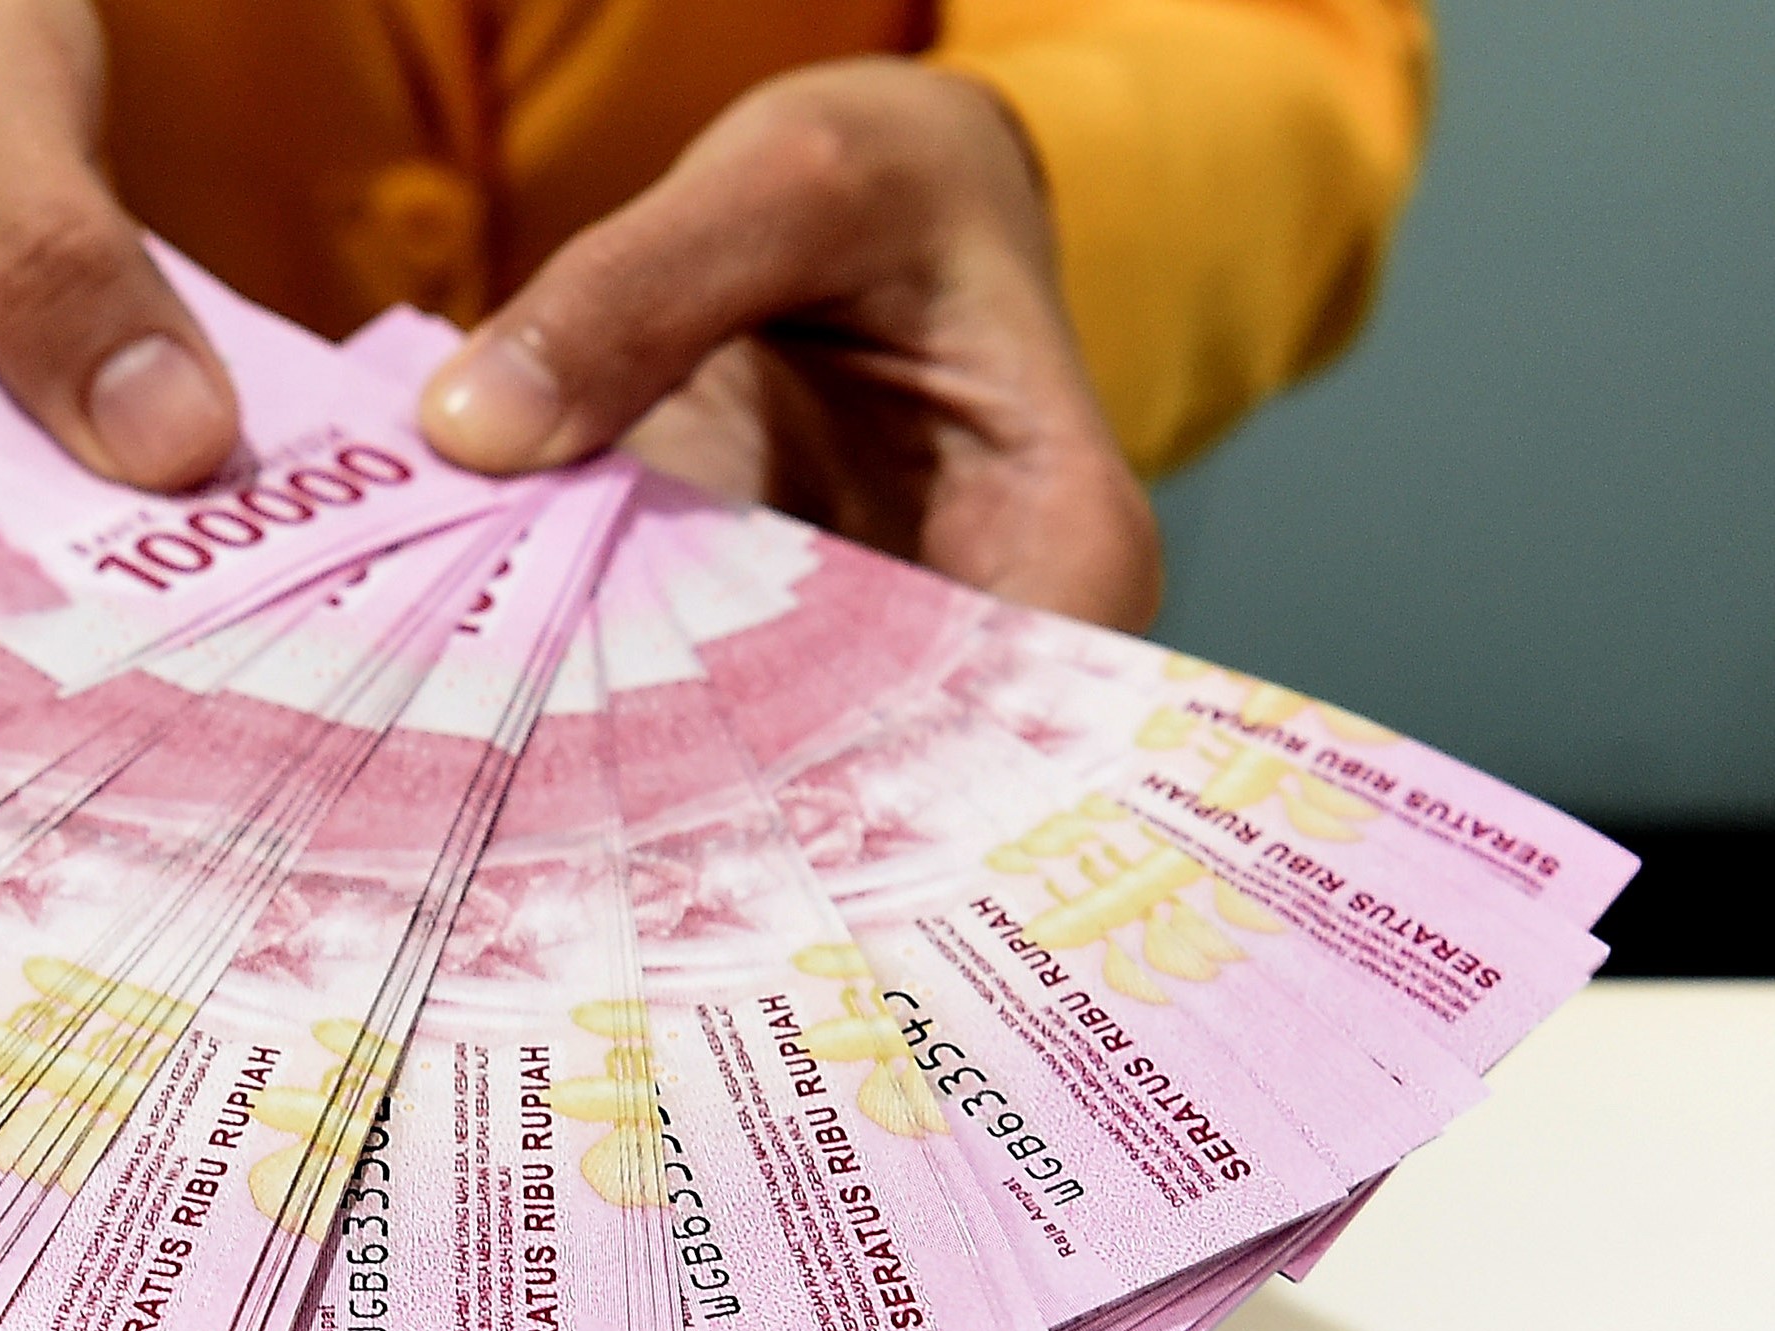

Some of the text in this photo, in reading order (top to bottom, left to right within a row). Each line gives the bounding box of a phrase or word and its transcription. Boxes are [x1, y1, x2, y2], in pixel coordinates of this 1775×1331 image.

[95, 442, 416, 592] 100000
[1142, 774, 1263, 846] RUPIAH
[1315, 750, 1398, 794] RIBU
[1262, 842, 1346, 895] RIBU
[1404, 790, 1560, 878] SERATUS
[1347, 892, 1502, 990] SERATUS
[969, 896, 1252, 1182] SERATUS RIBU RUPIAH
[170, 1157, 229, 1228] RIBU
[208, 1045, 281, 1149] RUPIAH
[519, 1046, 553, 1152] RUPIAH
[522, 1163, 556, 1233] RIBU
[757, 994, 924, 1330] SERATUS RIBU RUPIAH
[1001, 1176, 1077, 1259] Raja Ampat
